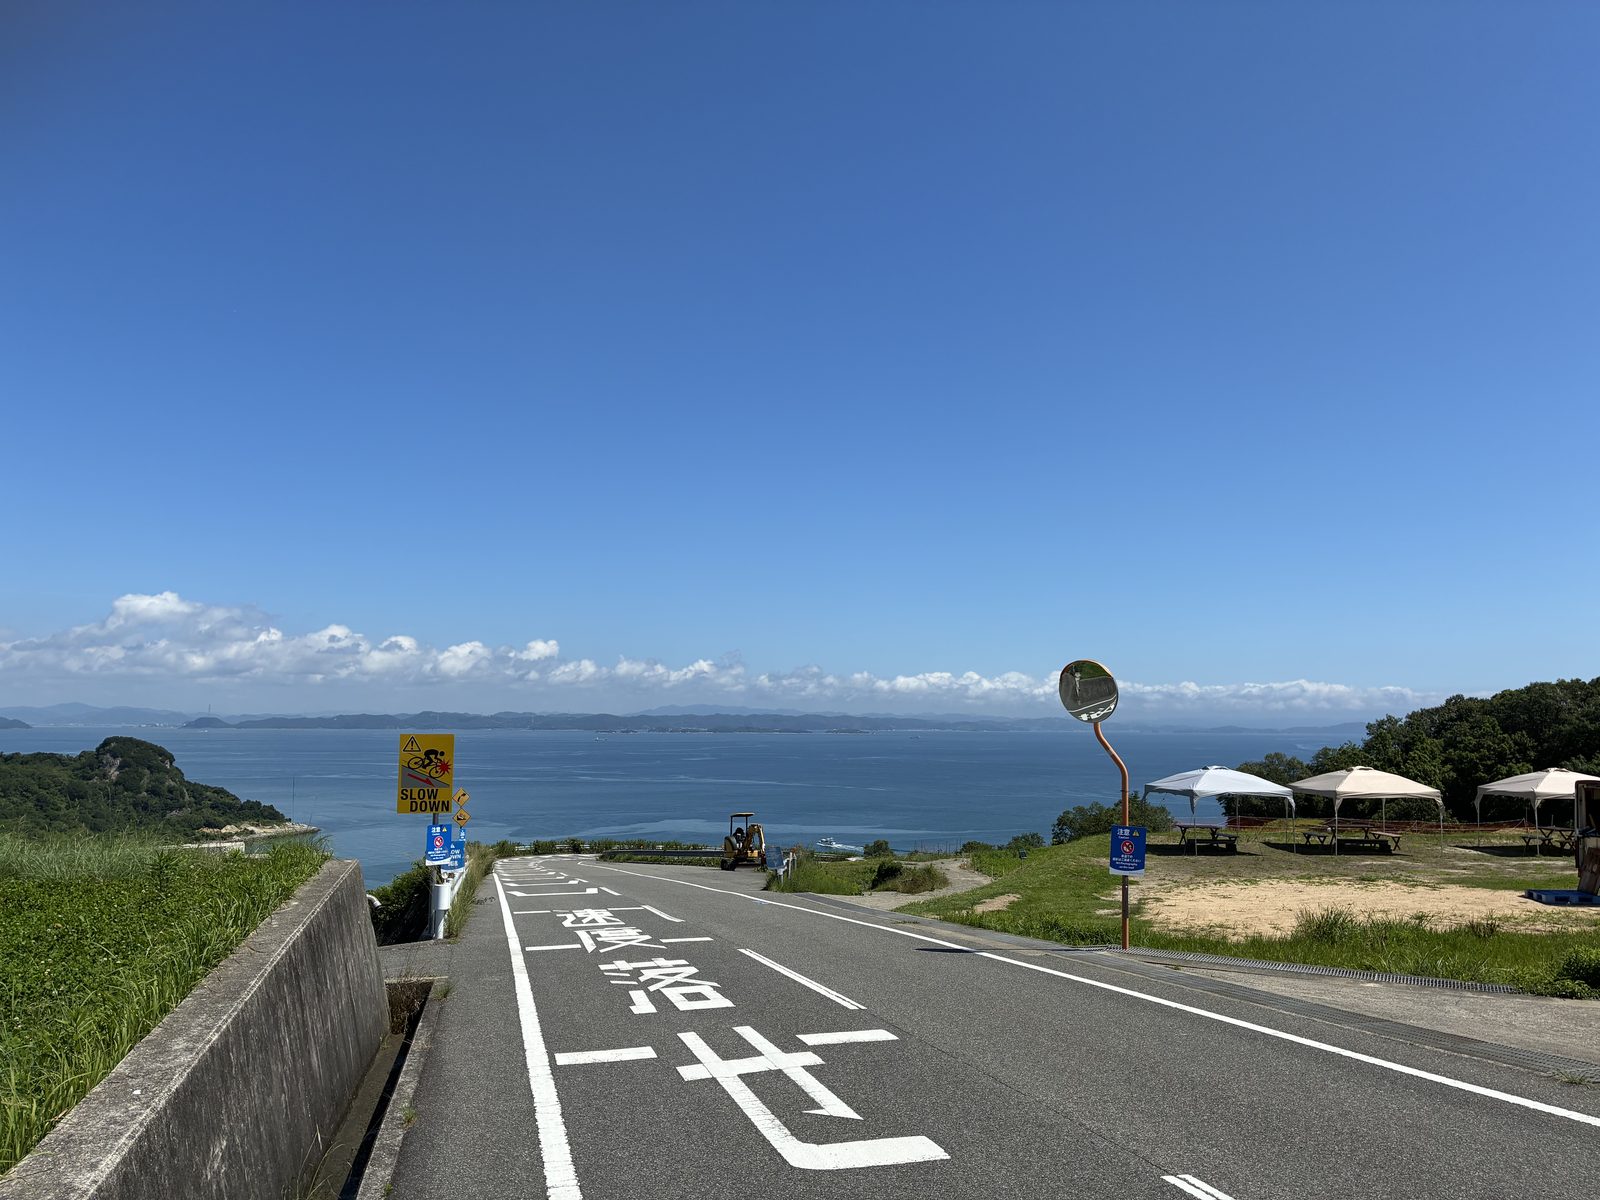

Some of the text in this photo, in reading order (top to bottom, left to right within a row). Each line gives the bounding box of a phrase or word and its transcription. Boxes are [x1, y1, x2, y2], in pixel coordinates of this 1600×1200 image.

[401, 788, 439, 801] SLOW
[410, 800, 449, 812] DOWN
[552, 908, 951, 1170] 速度落せ
